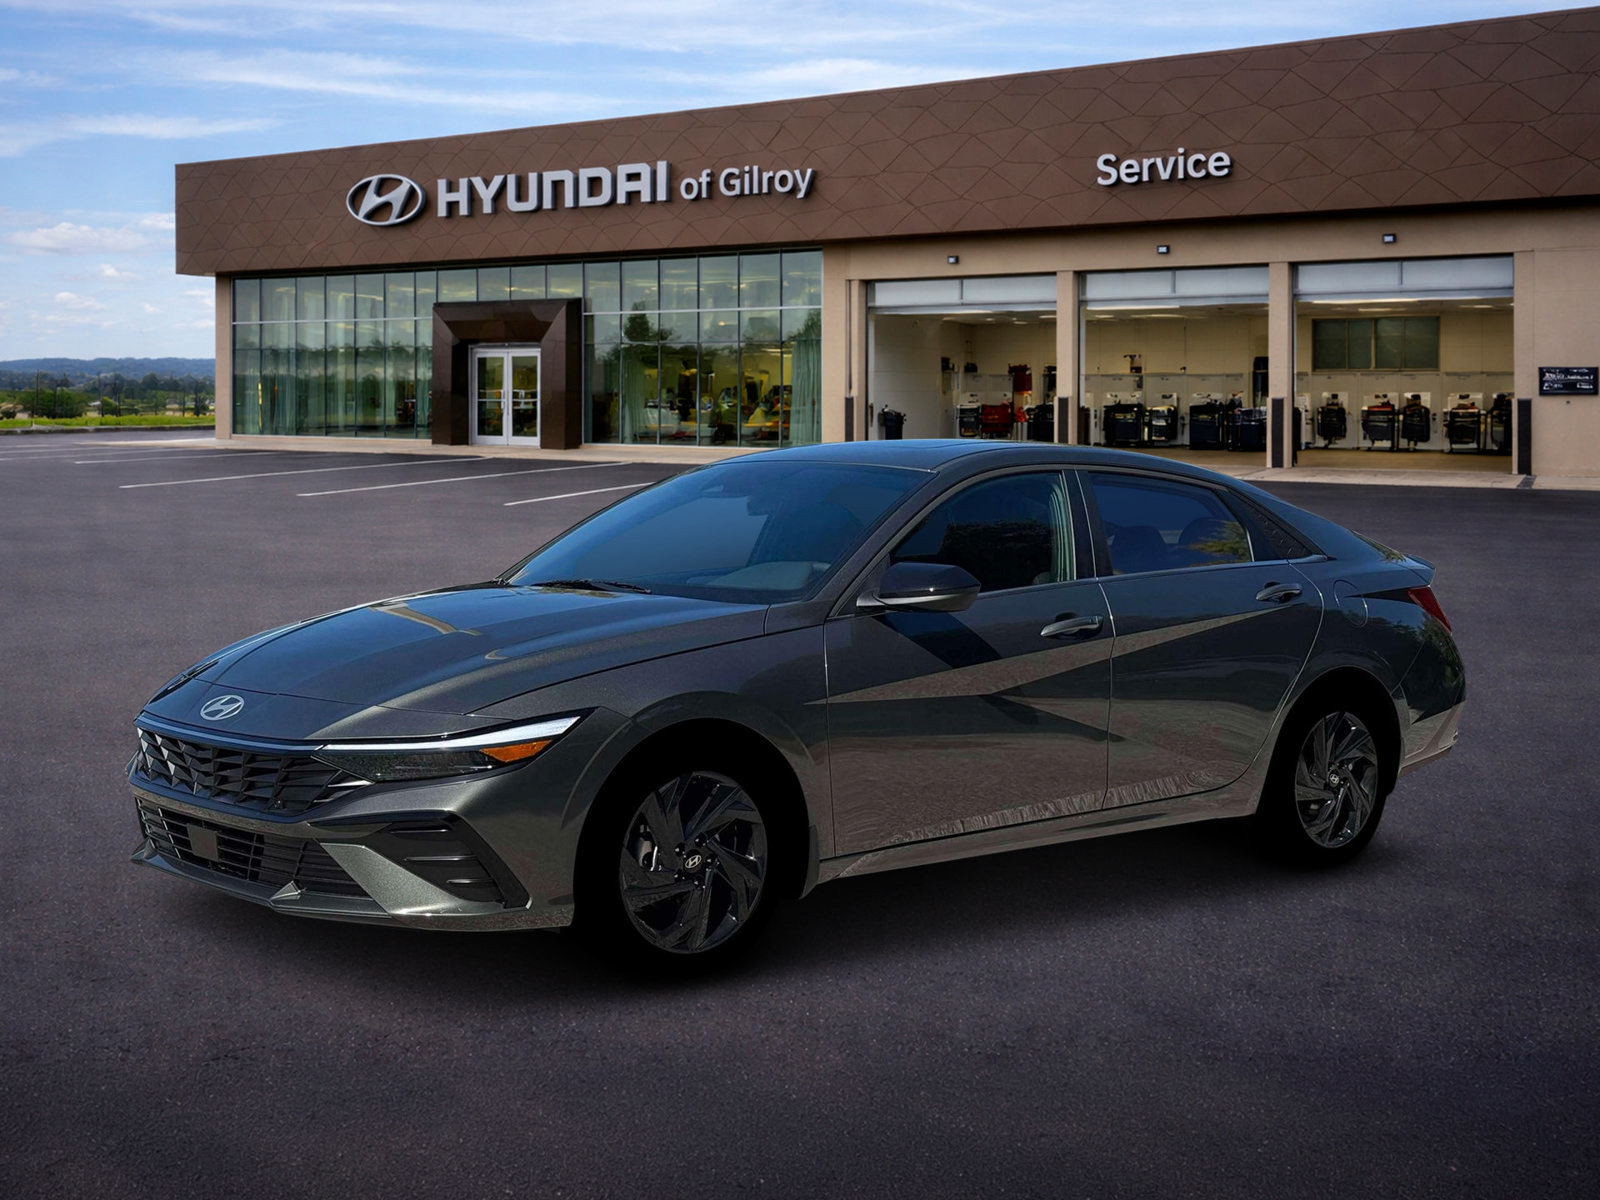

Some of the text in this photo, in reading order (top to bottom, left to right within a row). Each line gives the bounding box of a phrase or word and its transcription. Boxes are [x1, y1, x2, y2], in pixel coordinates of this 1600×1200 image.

[437, 160, 668, 218] HYUNDAI
[680, 168, 712, 200] of
[719, 165, 813, 199] Gilroy
[1096, 147, 1232, 186] Service
